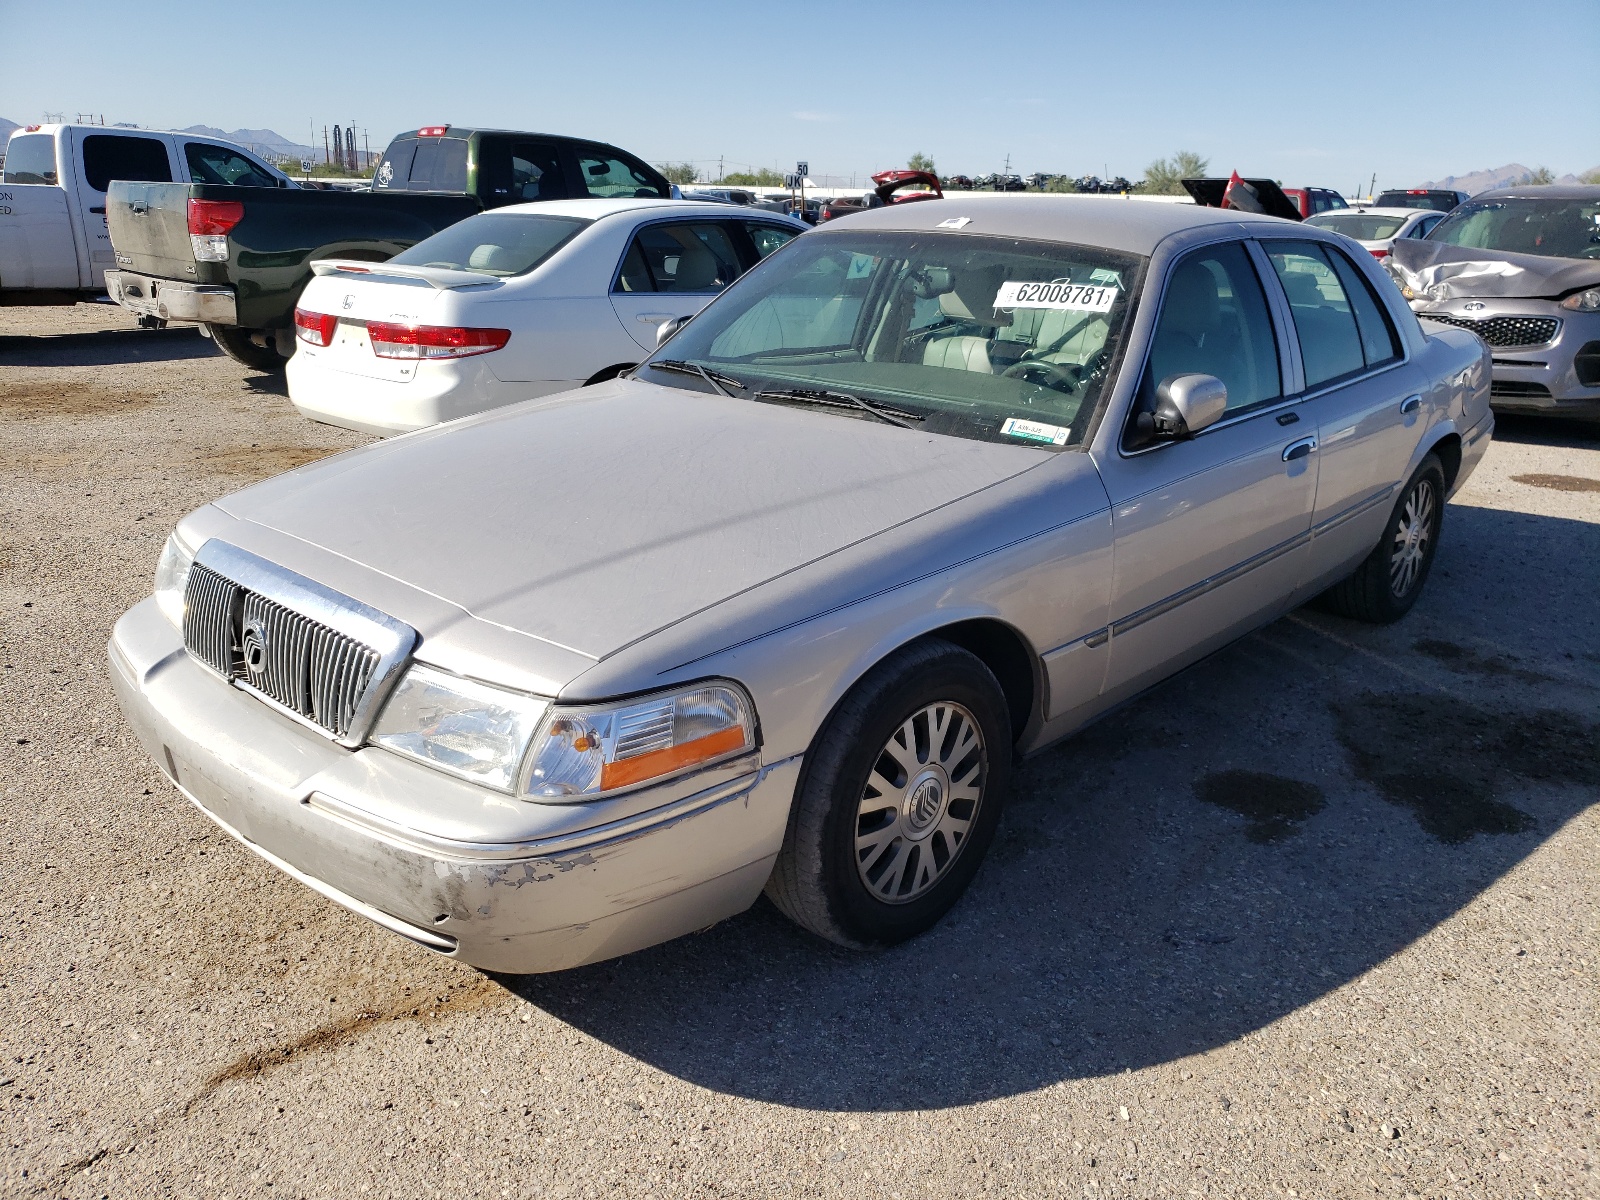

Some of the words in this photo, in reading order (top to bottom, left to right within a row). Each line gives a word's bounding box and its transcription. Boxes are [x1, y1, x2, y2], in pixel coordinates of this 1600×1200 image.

[798, 164, 808, 176] 50
[787, 175, 801, 187] JK
[1016, 283, 1106, 306] 62008781
[1007, 420, 1016, 433] 1
